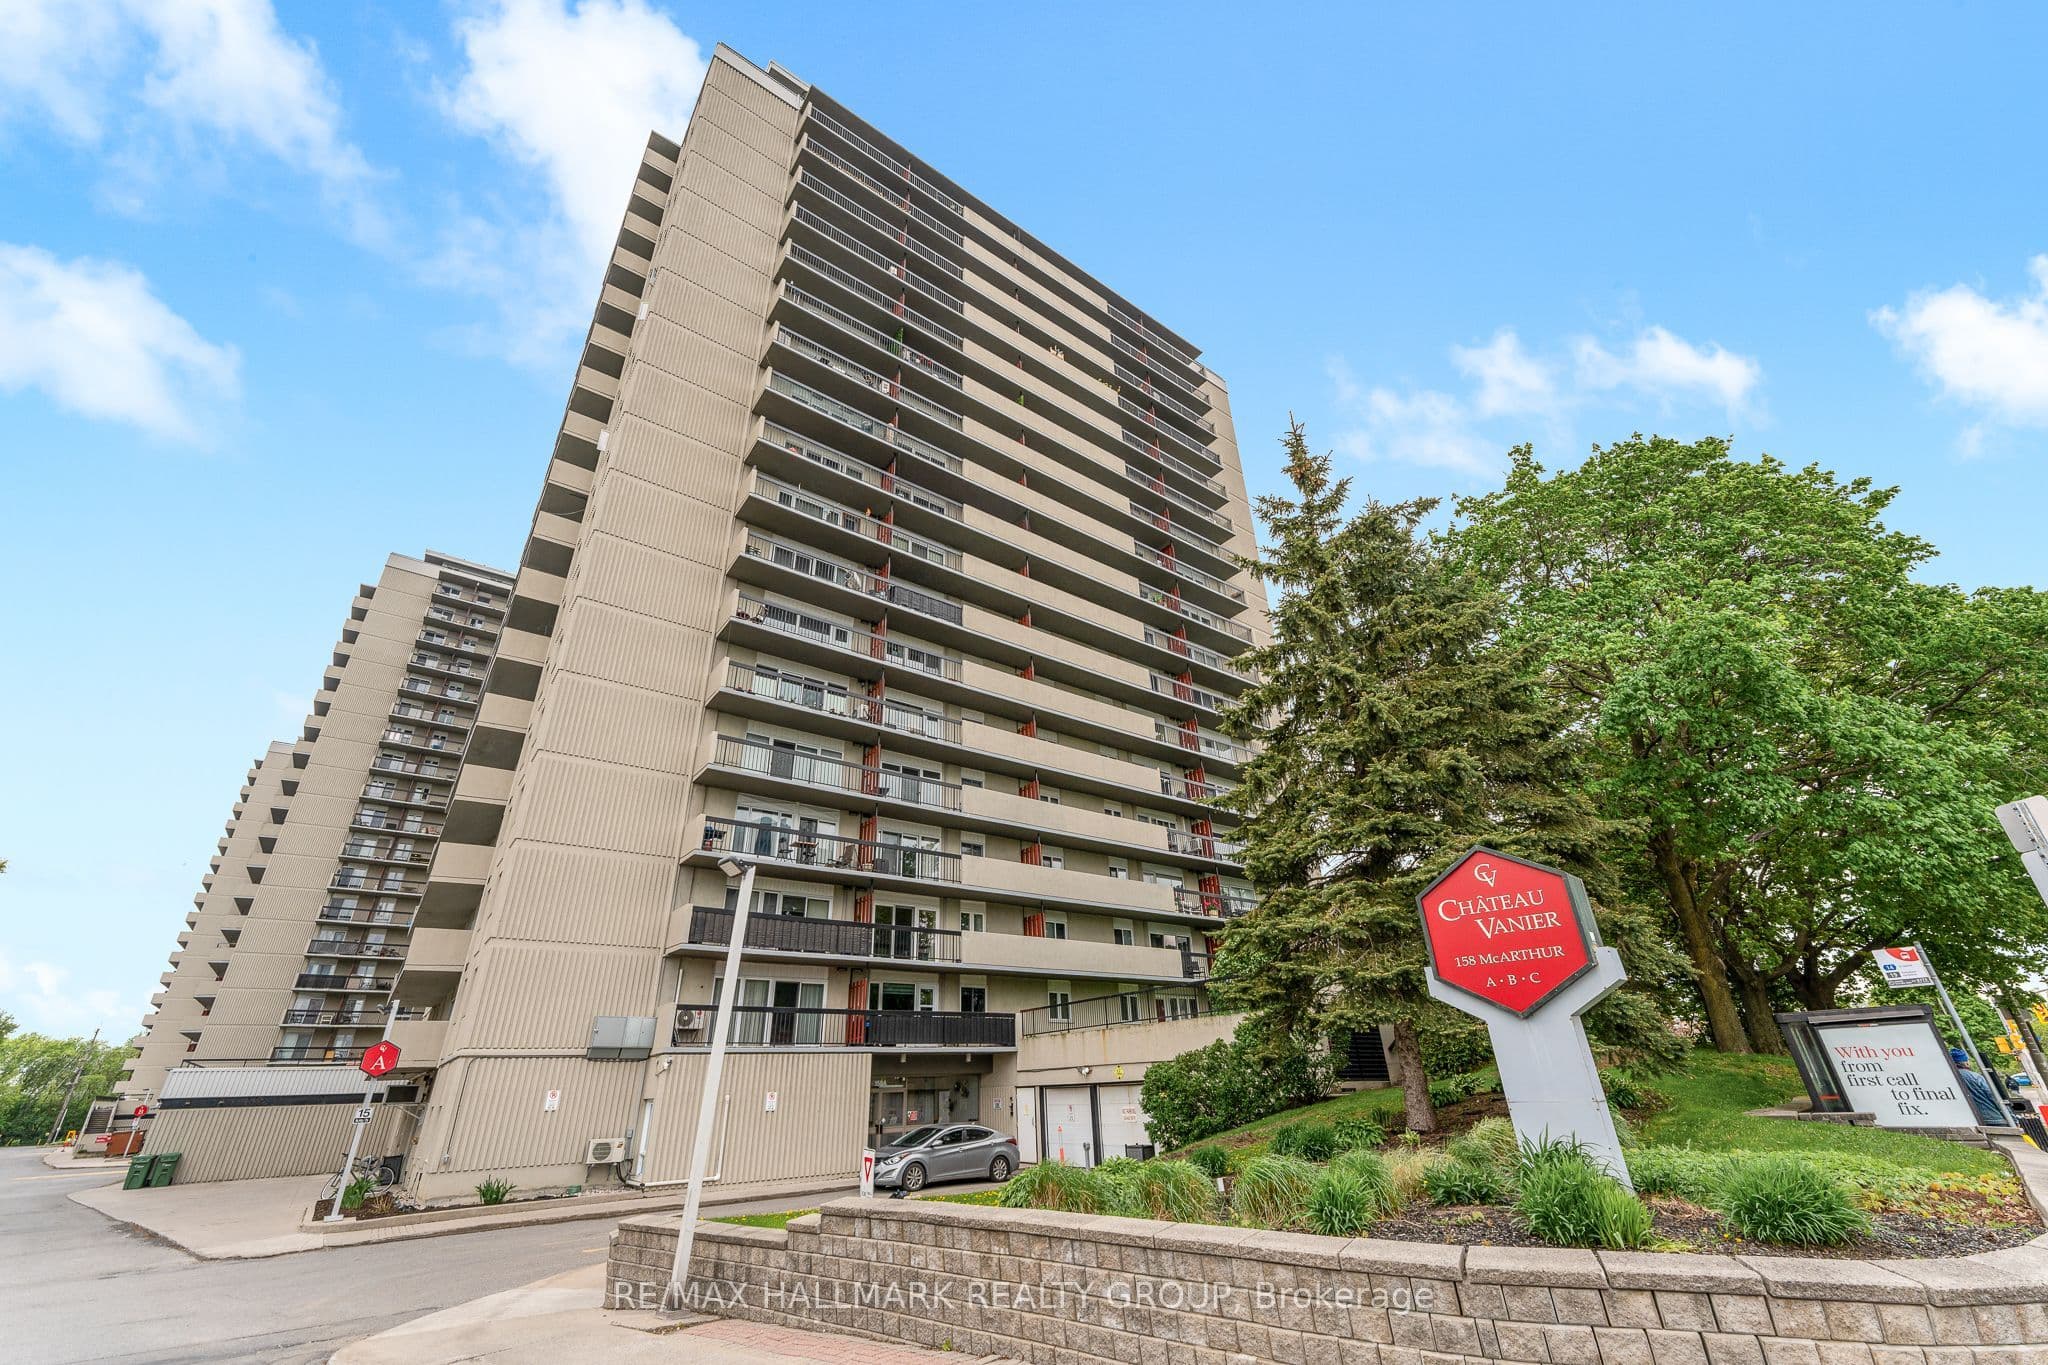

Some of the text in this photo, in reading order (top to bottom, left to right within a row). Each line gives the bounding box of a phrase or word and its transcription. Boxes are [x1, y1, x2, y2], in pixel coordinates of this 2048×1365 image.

[1475, 911, 1561, 939] VANIER
[1454, 945, 1565, 967] 158 McARTHUR
[1834, 1046, 1915, 1060] With you
[370, 1055, 386, 1070] A
[1841, 1060, 1884, 1073] from
[1847, 1072, 1920, 1087] first call
[1891, 1087, 1957, 1101] to final
[359, 1108, 371, 1118] 15
[1898, 1102, 1929, 1116] fix.
